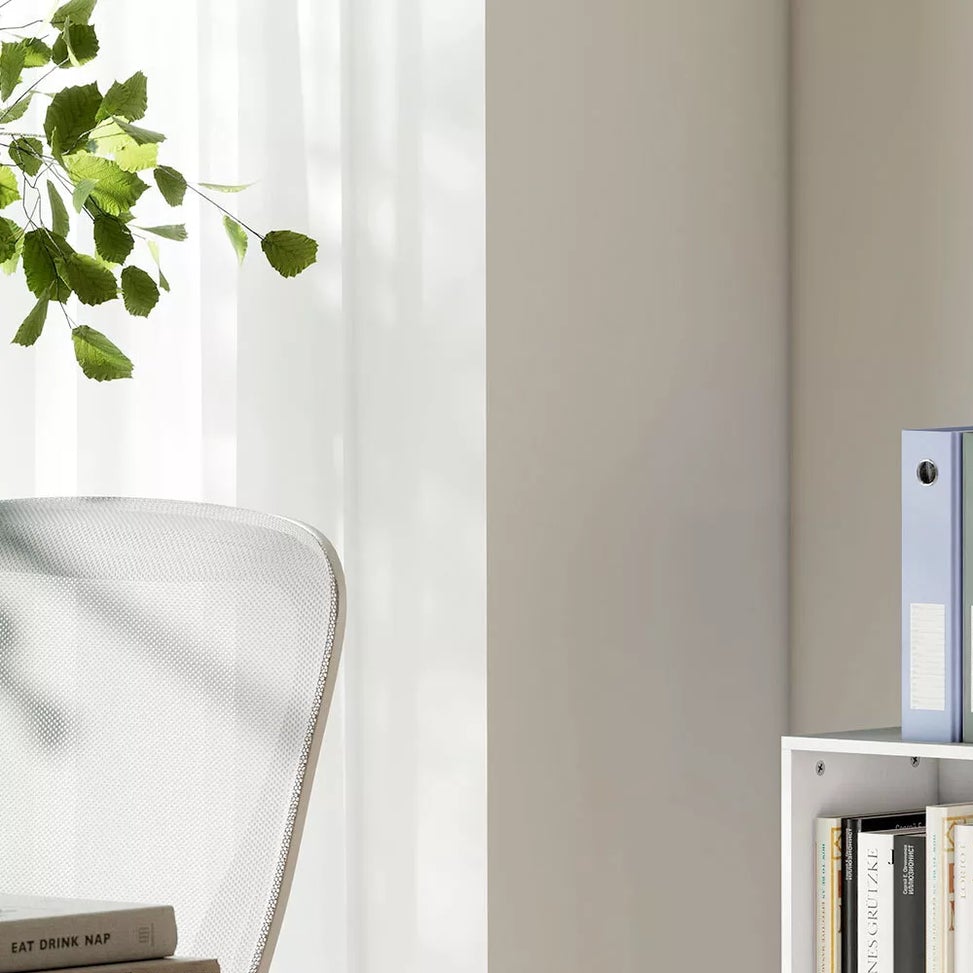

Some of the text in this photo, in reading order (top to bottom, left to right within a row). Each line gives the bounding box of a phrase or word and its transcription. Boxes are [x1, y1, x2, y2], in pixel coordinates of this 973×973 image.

[865, 847, 879, 936] GRÜTZKE
[959, 845, 967, 899] LORIOT
[11, 933, 111, 954] EAT DRINK NAP
